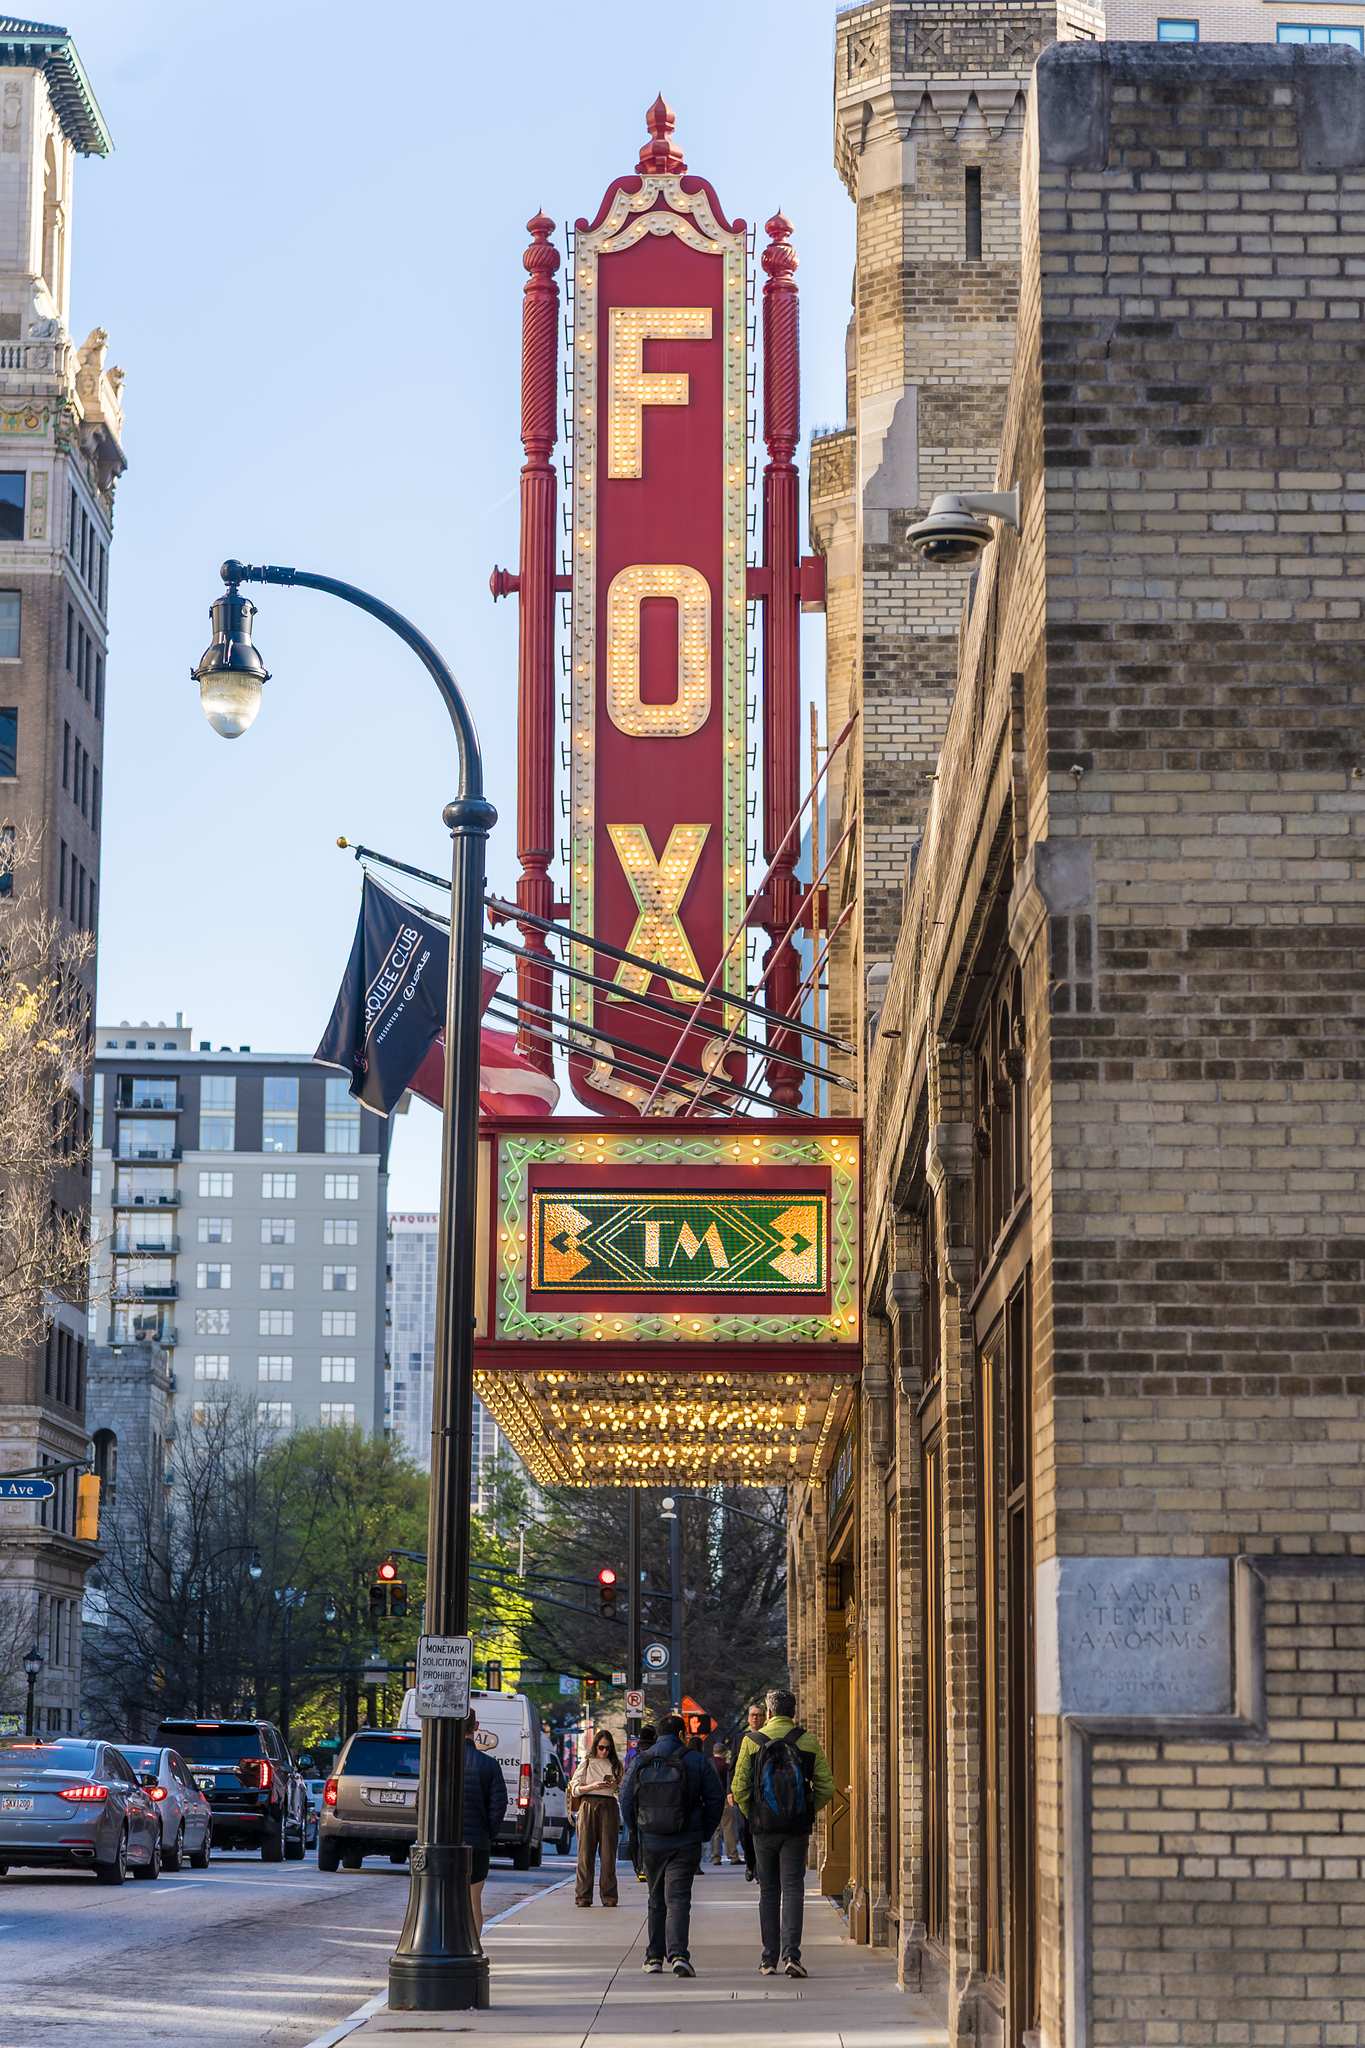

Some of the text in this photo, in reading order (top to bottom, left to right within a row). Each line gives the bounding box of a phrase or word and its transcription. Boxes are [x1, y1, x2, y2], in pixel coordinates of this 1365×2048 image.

[607, 307, 713, 1003] FOX
[391, 927, 418, 968] CLUB
[410, 950, 430, 987] LEXUS
[376, 1002, 405, 1044] PRESENTED BY
[8, 1483, 34, 1495] Ave
[1087, 1583, 1201, 1601] YAARAB
[1092, 1606, 1194, 1626] TEMPLE
[426, 1644, 465, 1655] MONETARY
[422, 1657, 468, 1668] SOLICITATION
